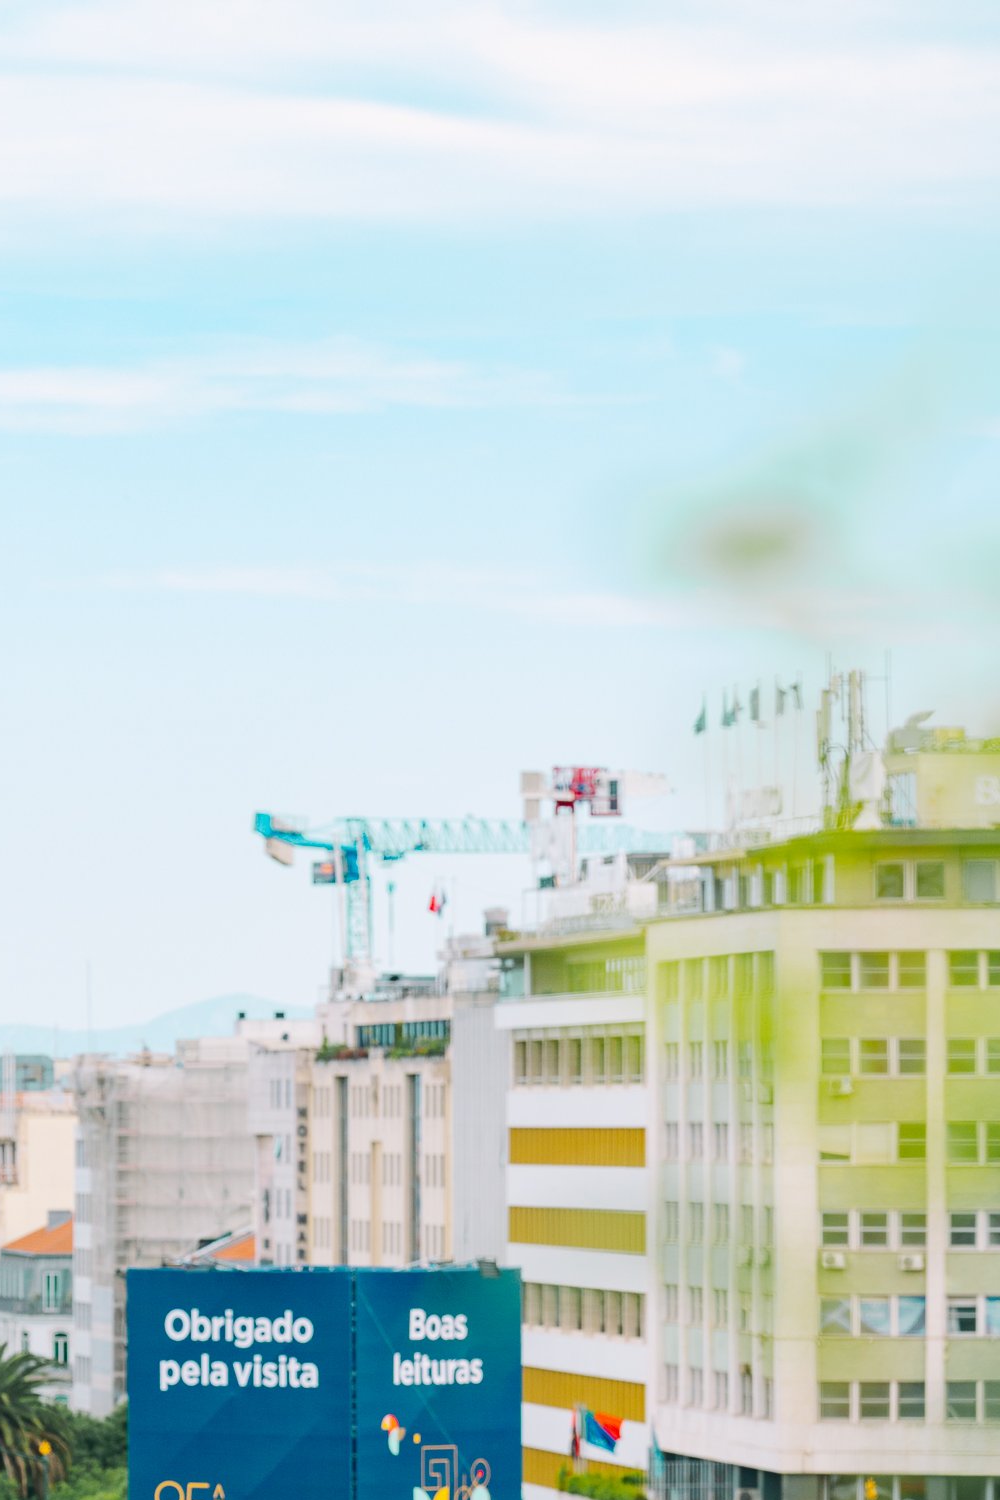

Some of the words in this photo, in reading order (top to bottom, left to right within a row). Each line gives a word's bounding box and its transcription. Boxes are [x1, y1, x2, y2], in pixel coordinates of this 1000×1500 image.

[164, 1308, 314, 1348] Obrigado
[409, 1308, 468, 1341] Boas
[159, 1354, 229, 1391] pela
[233, 1354, 319, 1388] visita
[393, 1352, 484, 1385] leituras
